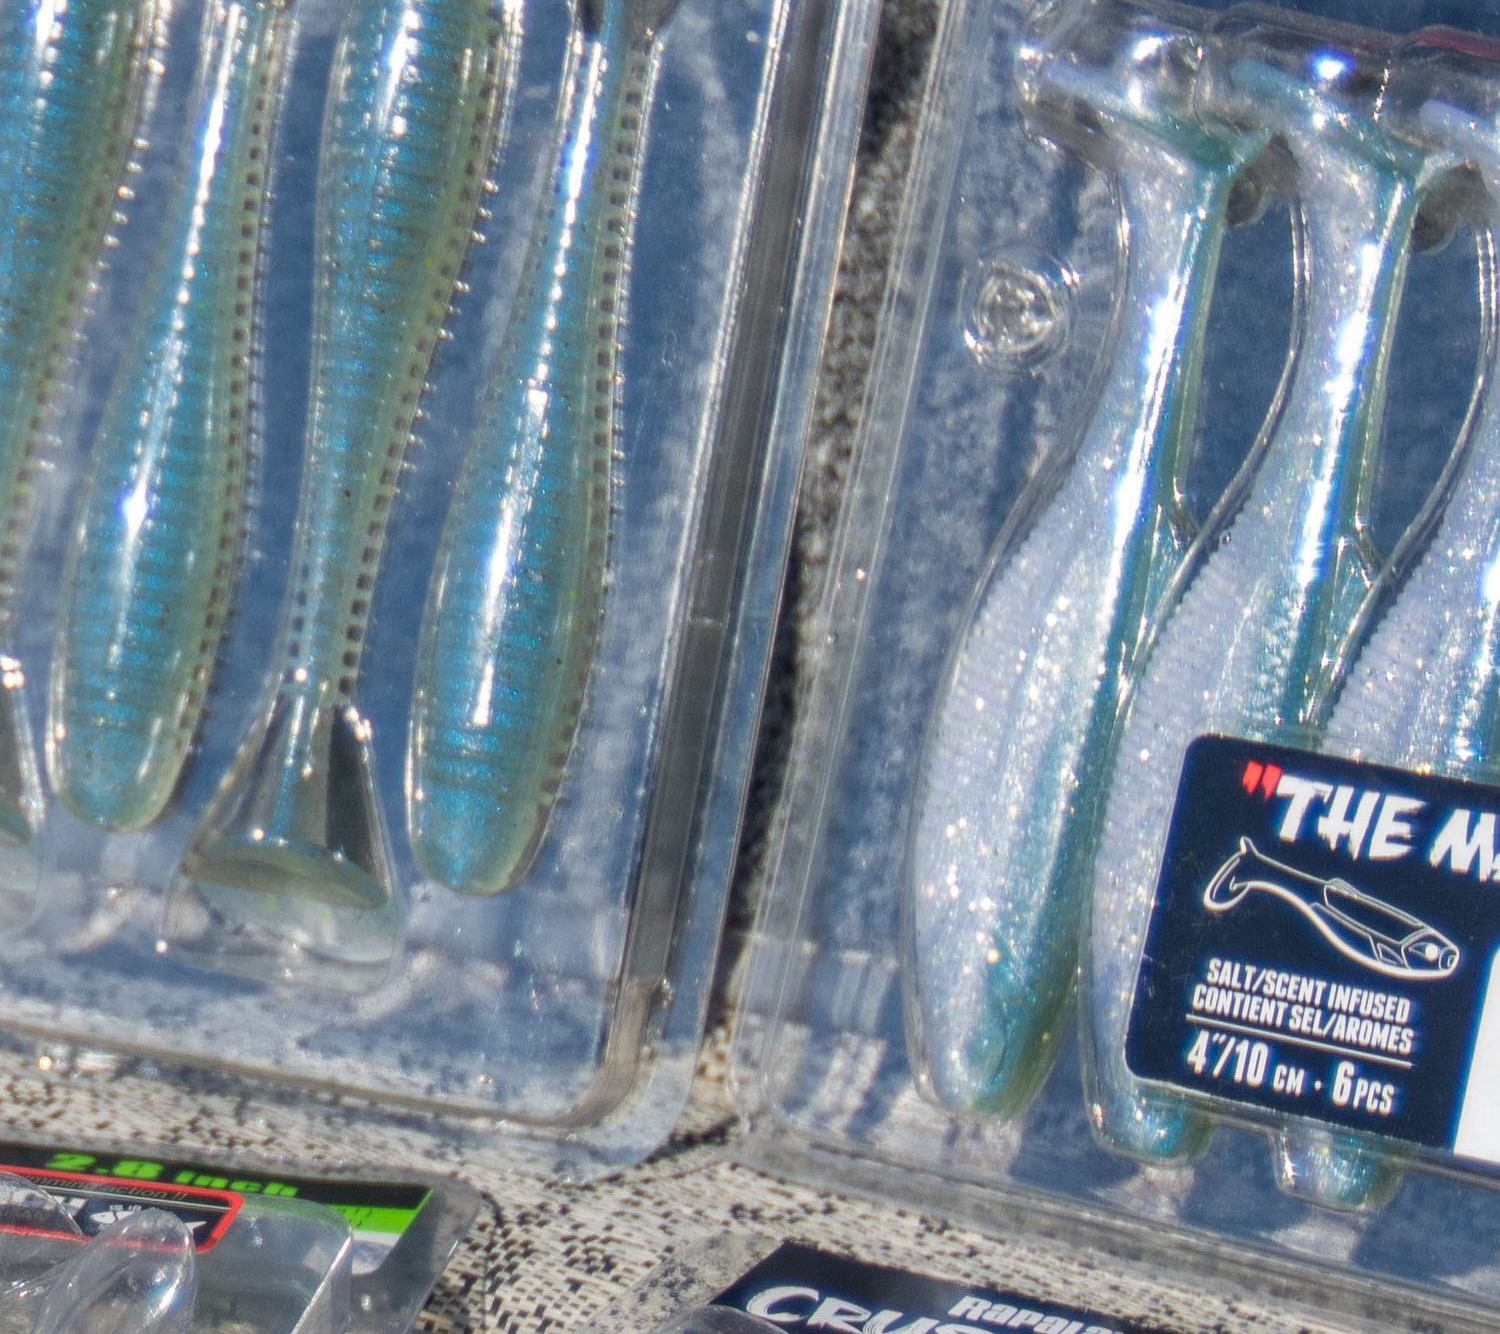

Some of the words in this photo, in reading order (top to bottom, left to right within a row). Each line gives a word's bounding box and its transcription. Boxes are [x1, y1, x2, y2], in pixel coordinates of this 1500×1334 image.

[1191, 983, 1289, 1028] CONTIENT
[1288, 1004, 1415, 1056] SEL/AROMES
[1206, 956, 1328, 1007] SALT/SCENT
[1327, 982, 1412, 1026] INFUSED
[1272, 1063, 1305, 1098] CM
[46, 1153, 165, 1180] 2.8
[174, 1170, 299, 1198] inch
